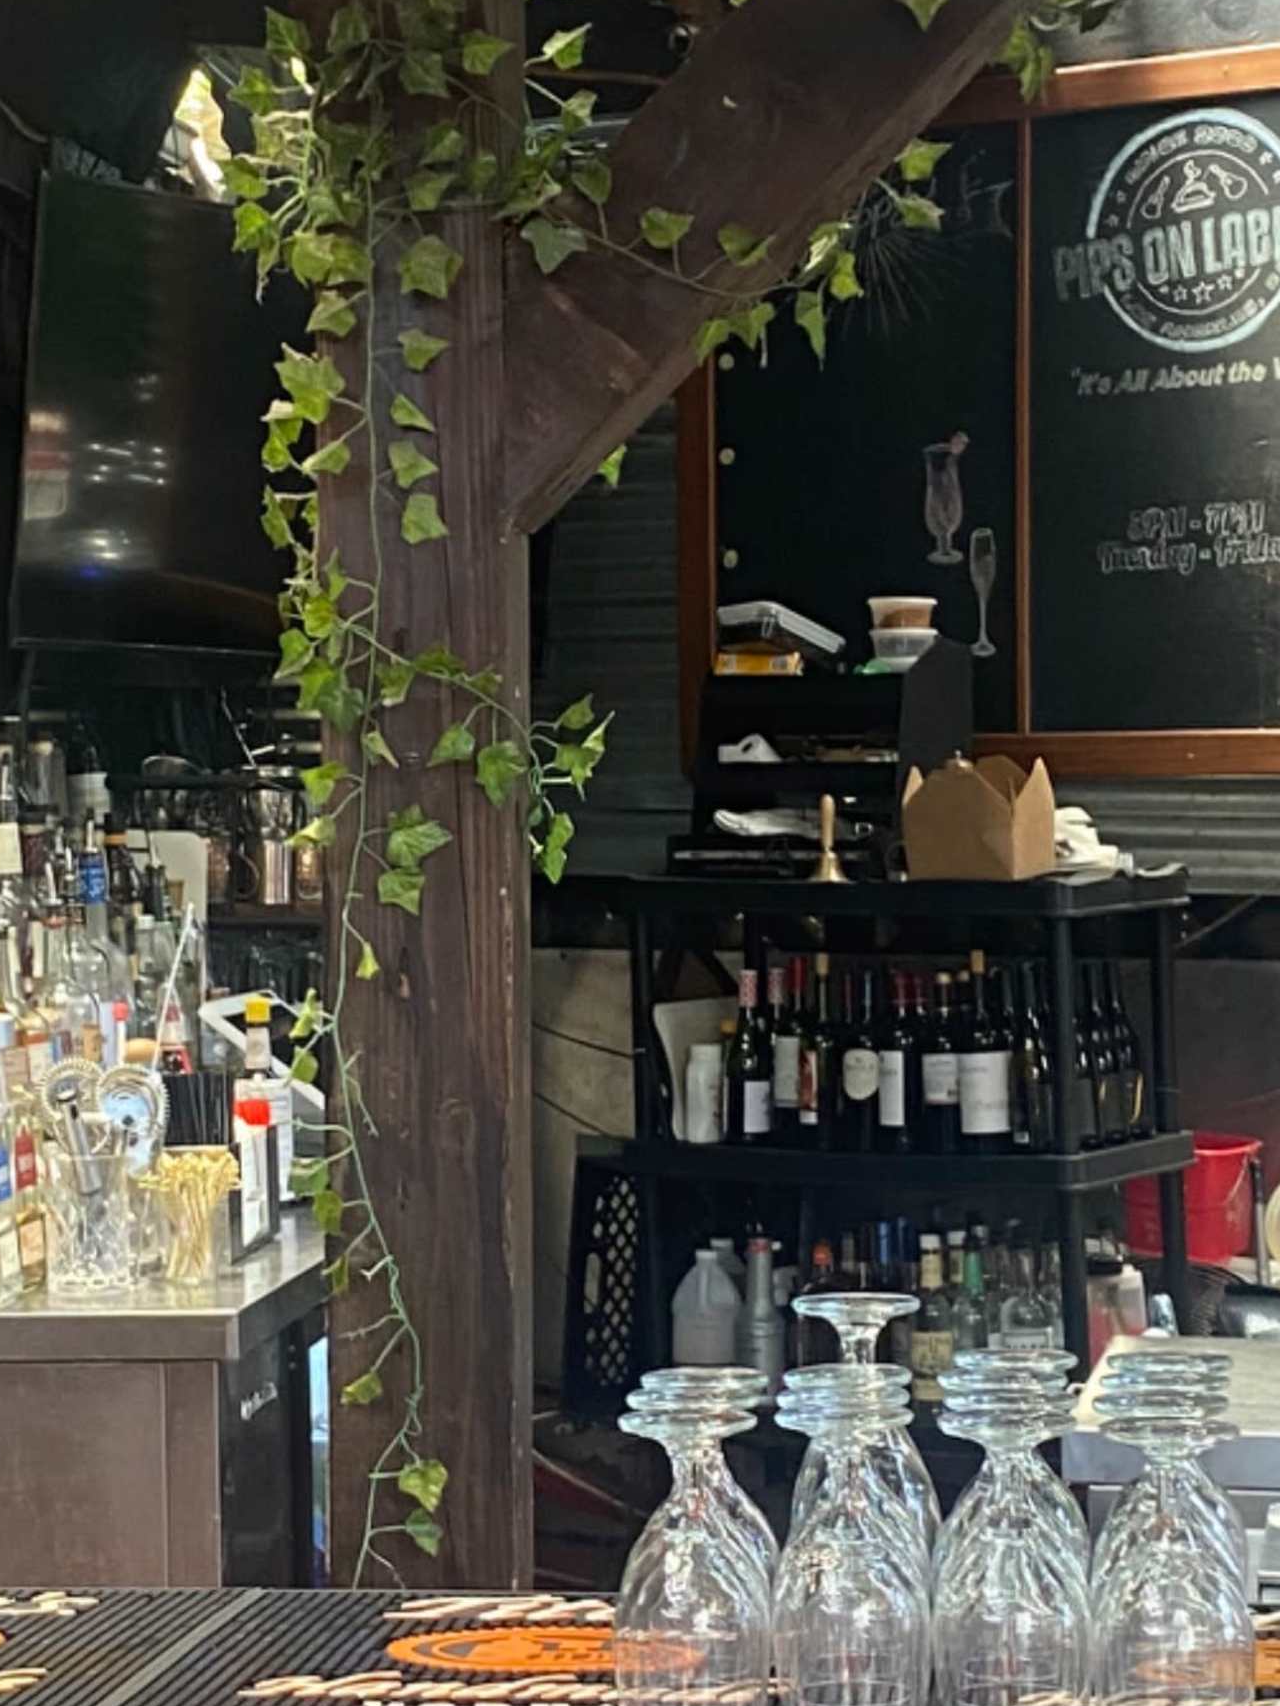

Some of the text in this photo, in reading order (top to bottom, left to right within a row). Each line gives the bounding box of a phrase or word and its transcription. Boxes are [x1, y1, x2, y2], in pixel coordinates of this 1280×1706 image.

[1054, 233, 1136, 301] PIPS
[1142, 220, 1197, 286] ON
[1150, 363, 1225, 392] About
[1228, 359, 1266, 382] the
